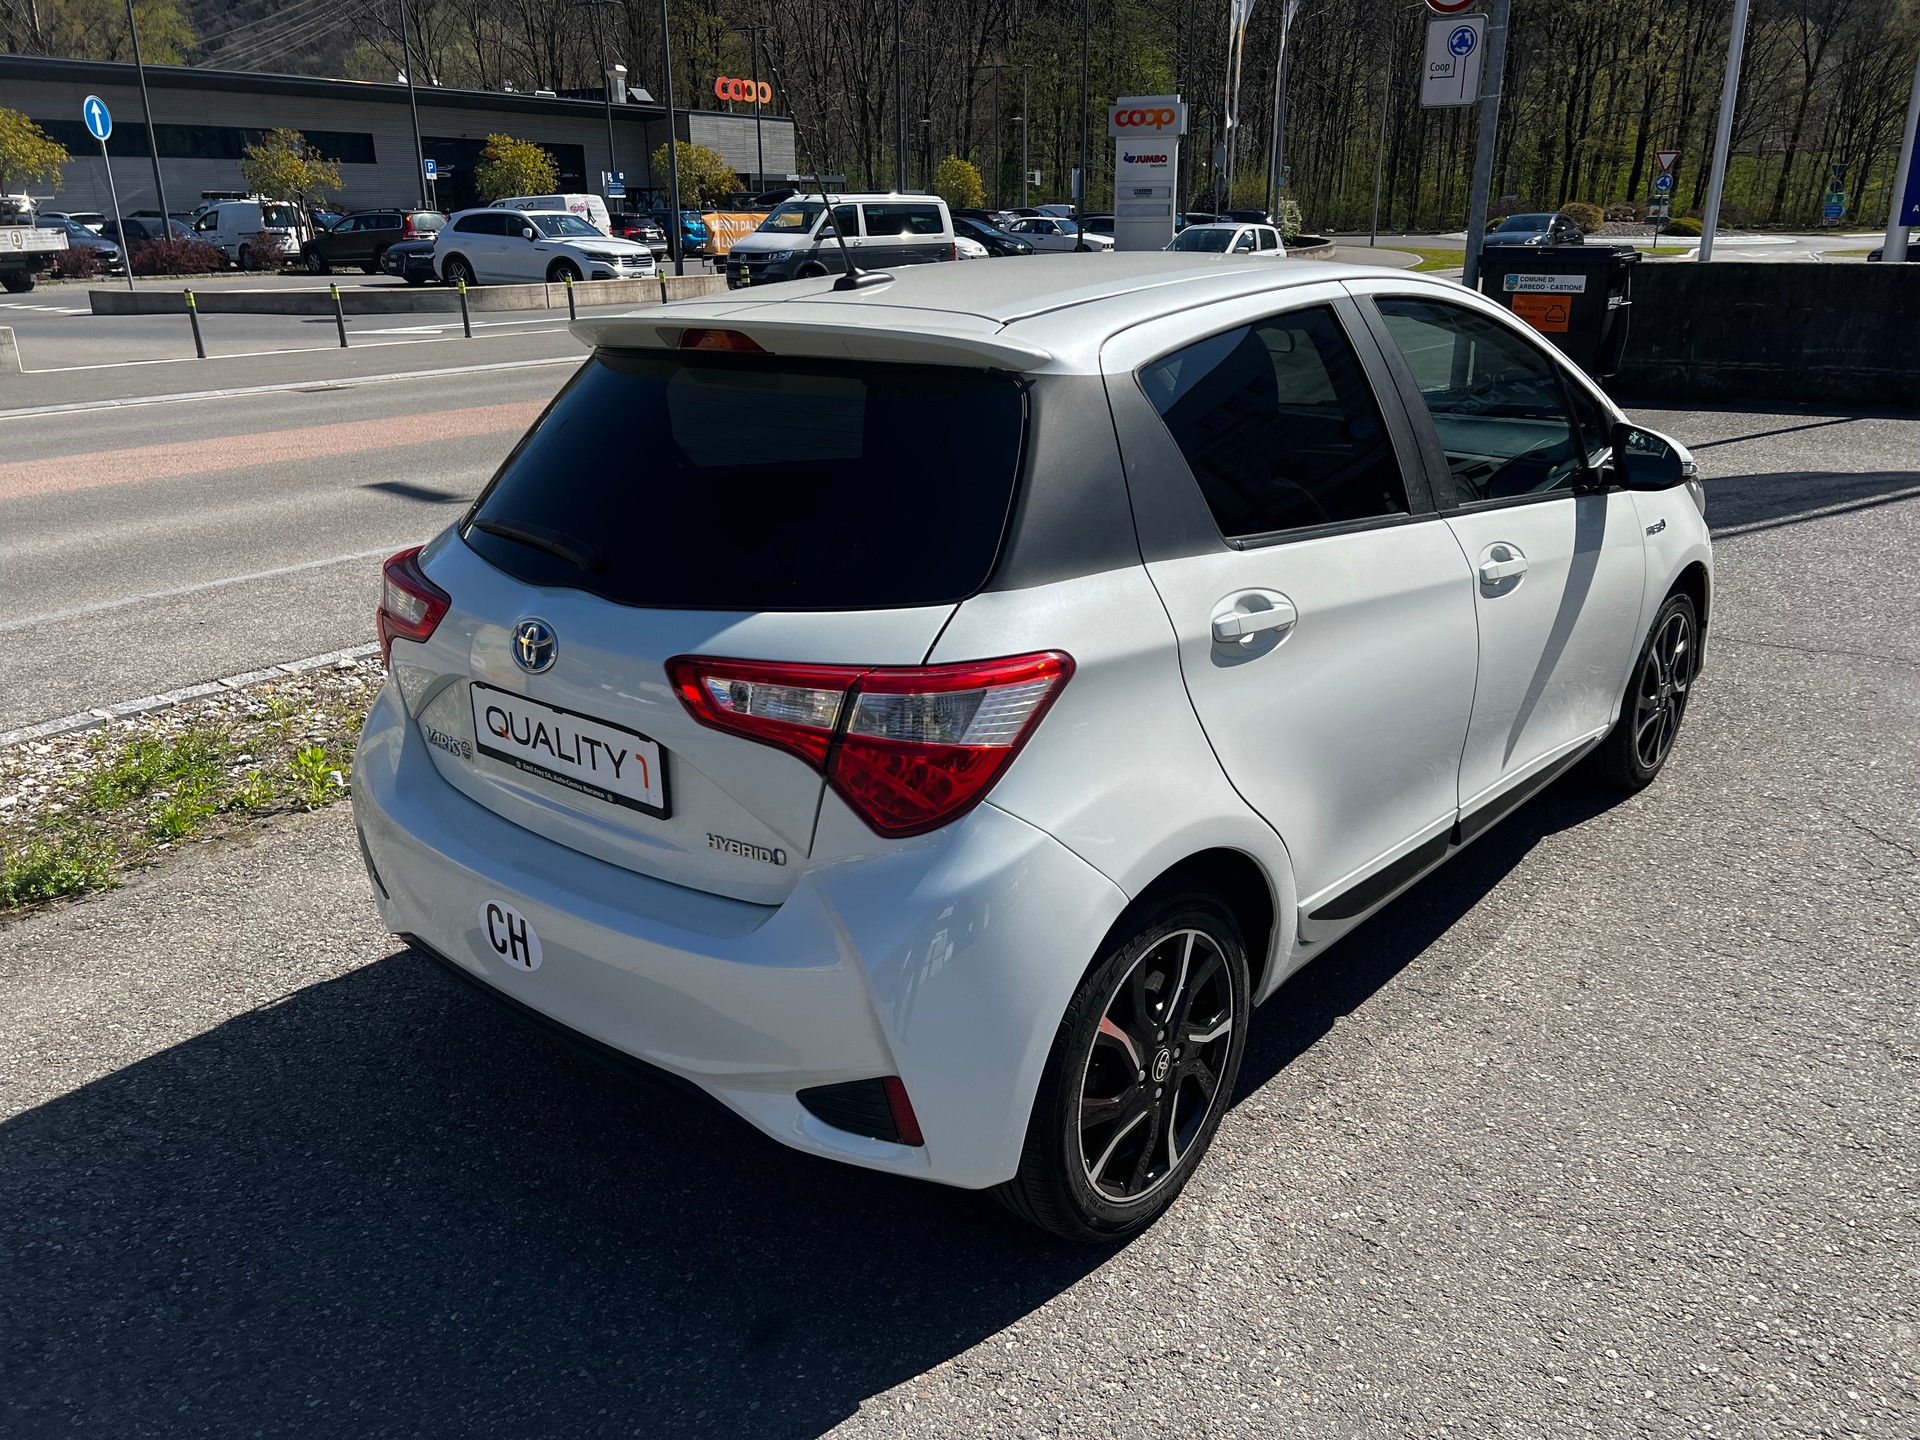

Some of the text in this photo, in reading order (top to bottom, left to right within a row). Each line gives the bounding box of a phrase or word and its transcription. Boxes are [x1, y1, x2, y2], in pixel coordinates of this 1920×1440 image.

[1430, 62, 1450, 73] Coop
[715, 76, 772, 109] coop
[1115, 108, 1175, 130] coop
[1135, 155, 1167, 163] JUMBO
[486, 706, 649, 789] QUALITY 1
[523, 763, 534, 772] Emil
[706, 833, 772, 863] HYBRID
[487, 903, 531, 968] CH
